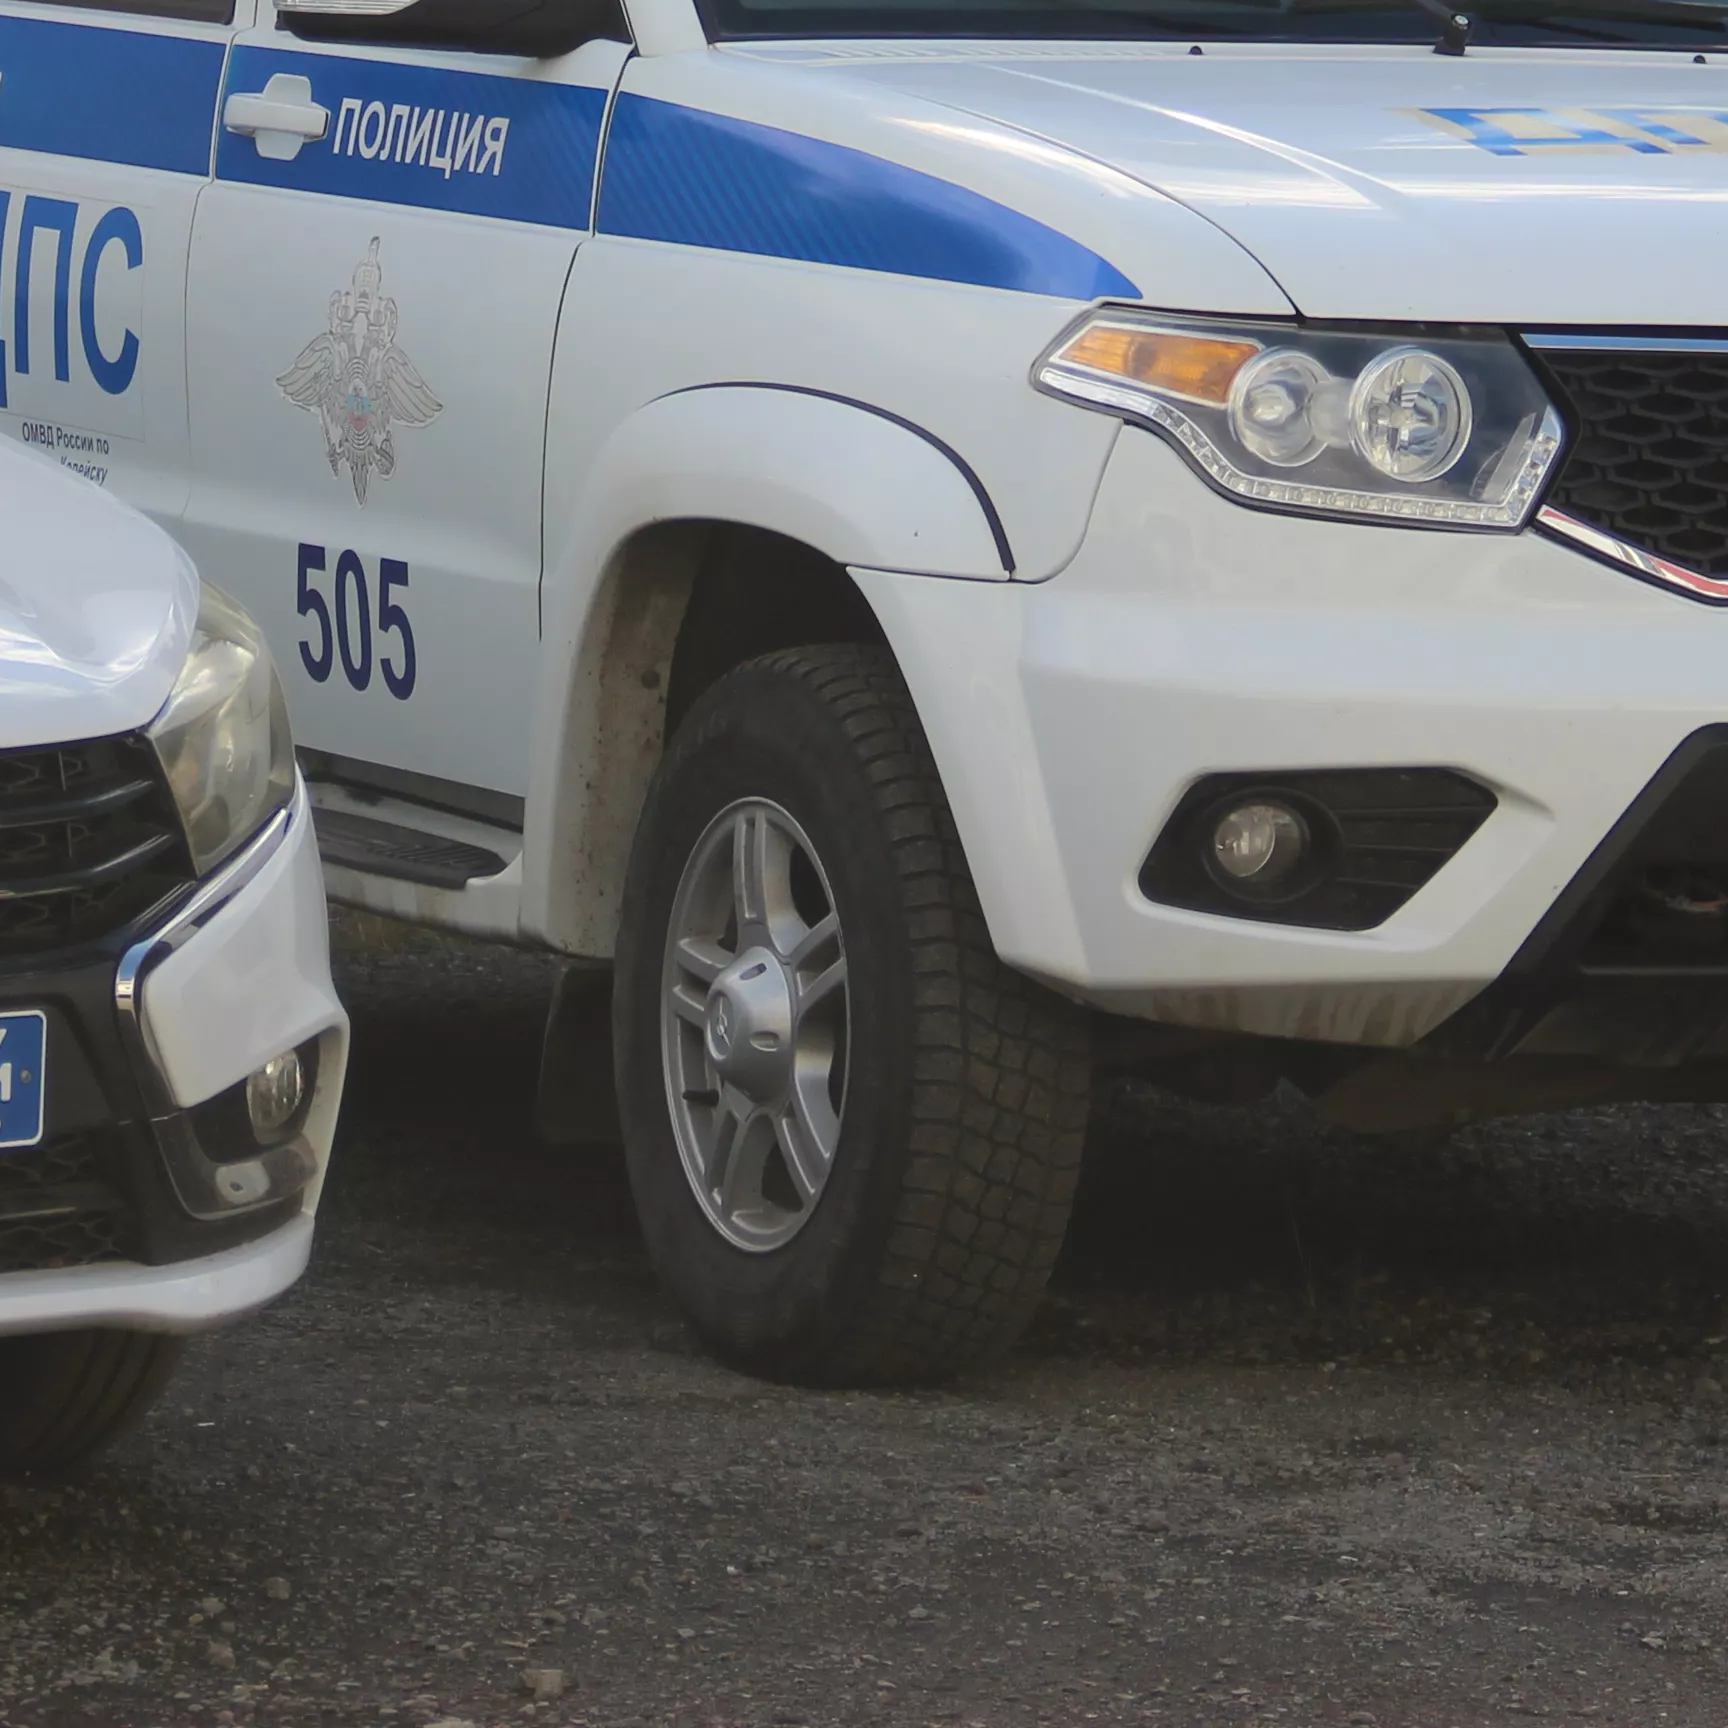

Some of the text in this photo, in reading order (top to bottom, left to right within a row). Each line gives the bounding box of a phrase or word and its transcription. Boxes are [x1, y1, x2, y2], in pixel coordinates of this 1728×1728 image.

[332, 97, 510, 179] ПОЛИЦИЯ
[22, 422, 109, 455] ОМВД России по
[297, 542, 416, 700] 505
